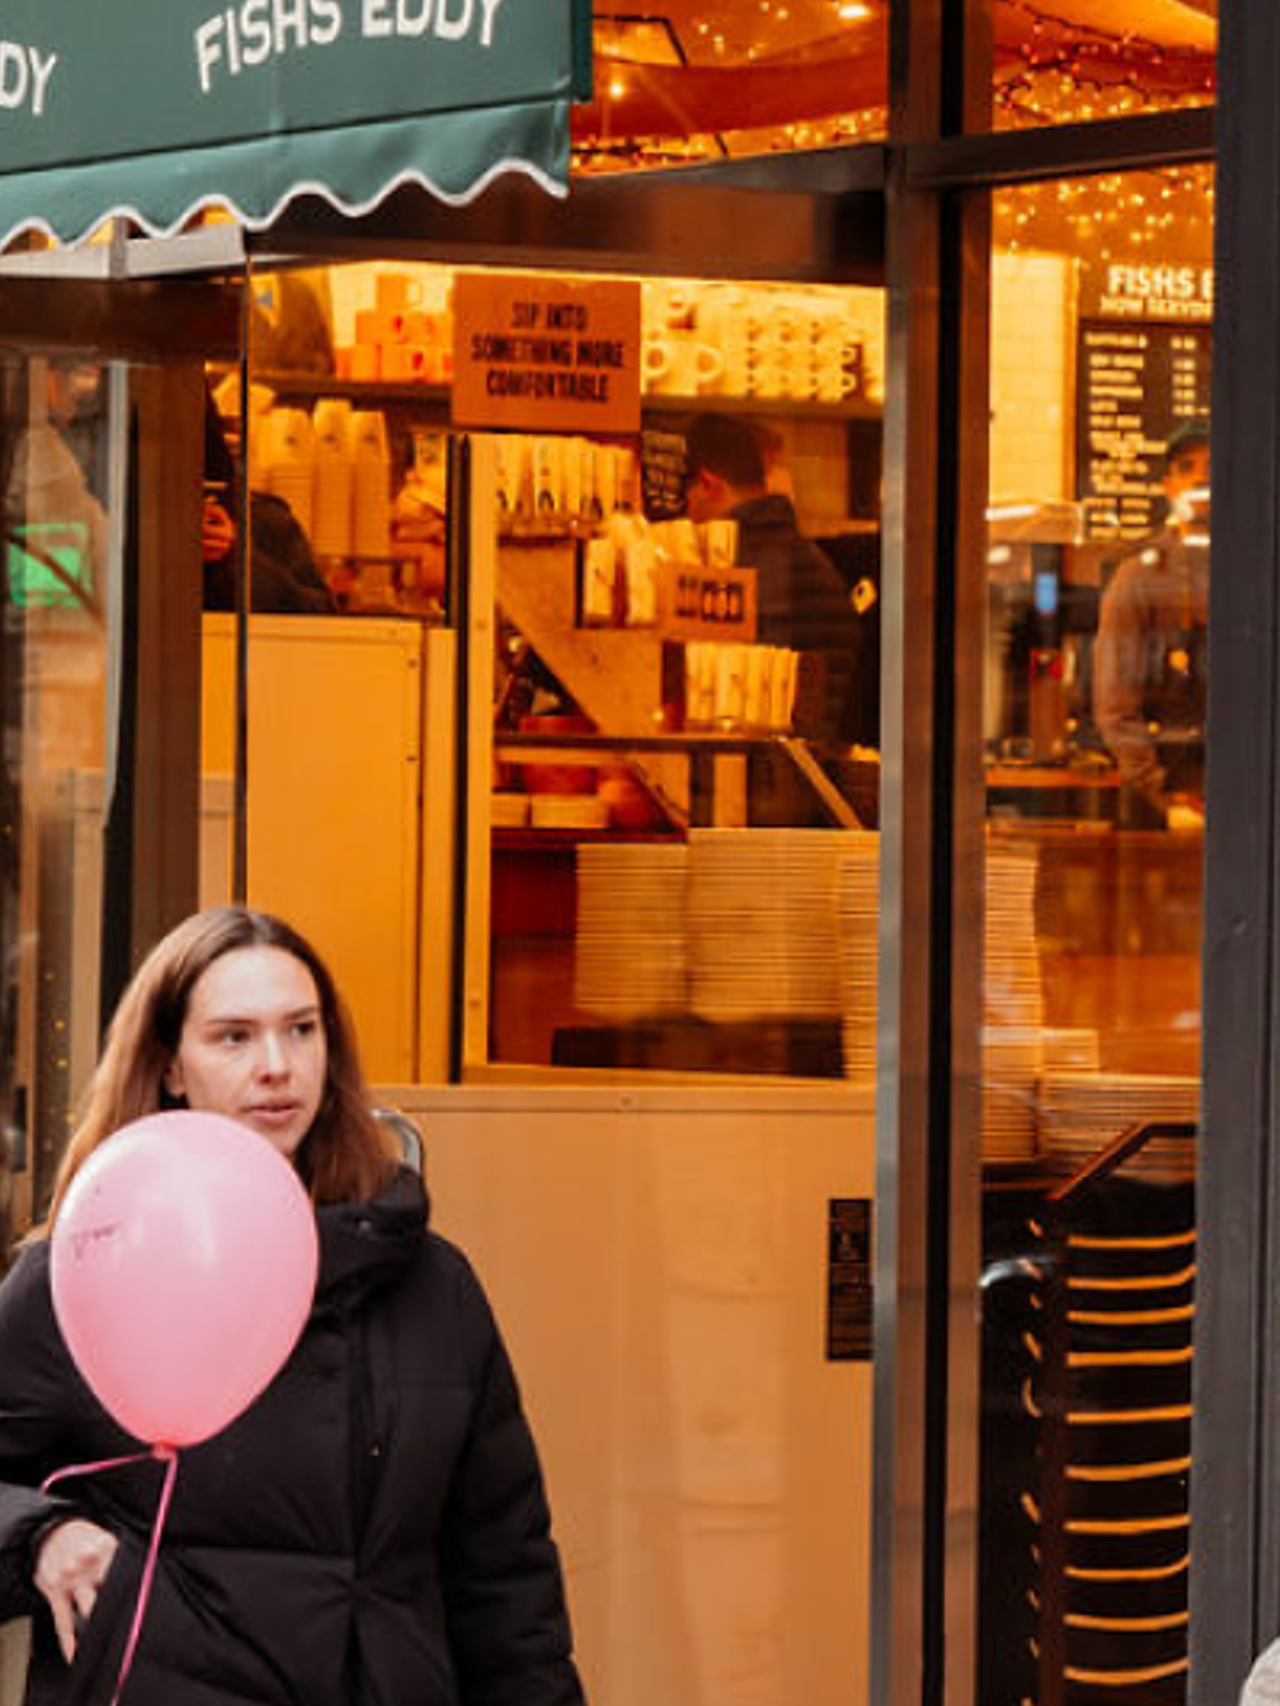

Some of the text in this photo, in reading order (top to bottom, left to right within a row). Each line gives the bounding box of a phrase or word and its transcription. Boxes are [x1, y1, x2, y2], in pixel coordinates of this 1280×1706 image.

[1108, 264, 1195, 299] FISHS
[471, 334, 624, 369] SOMETHING MORE
[486, 370, 610, 404] COMFORTABLE
